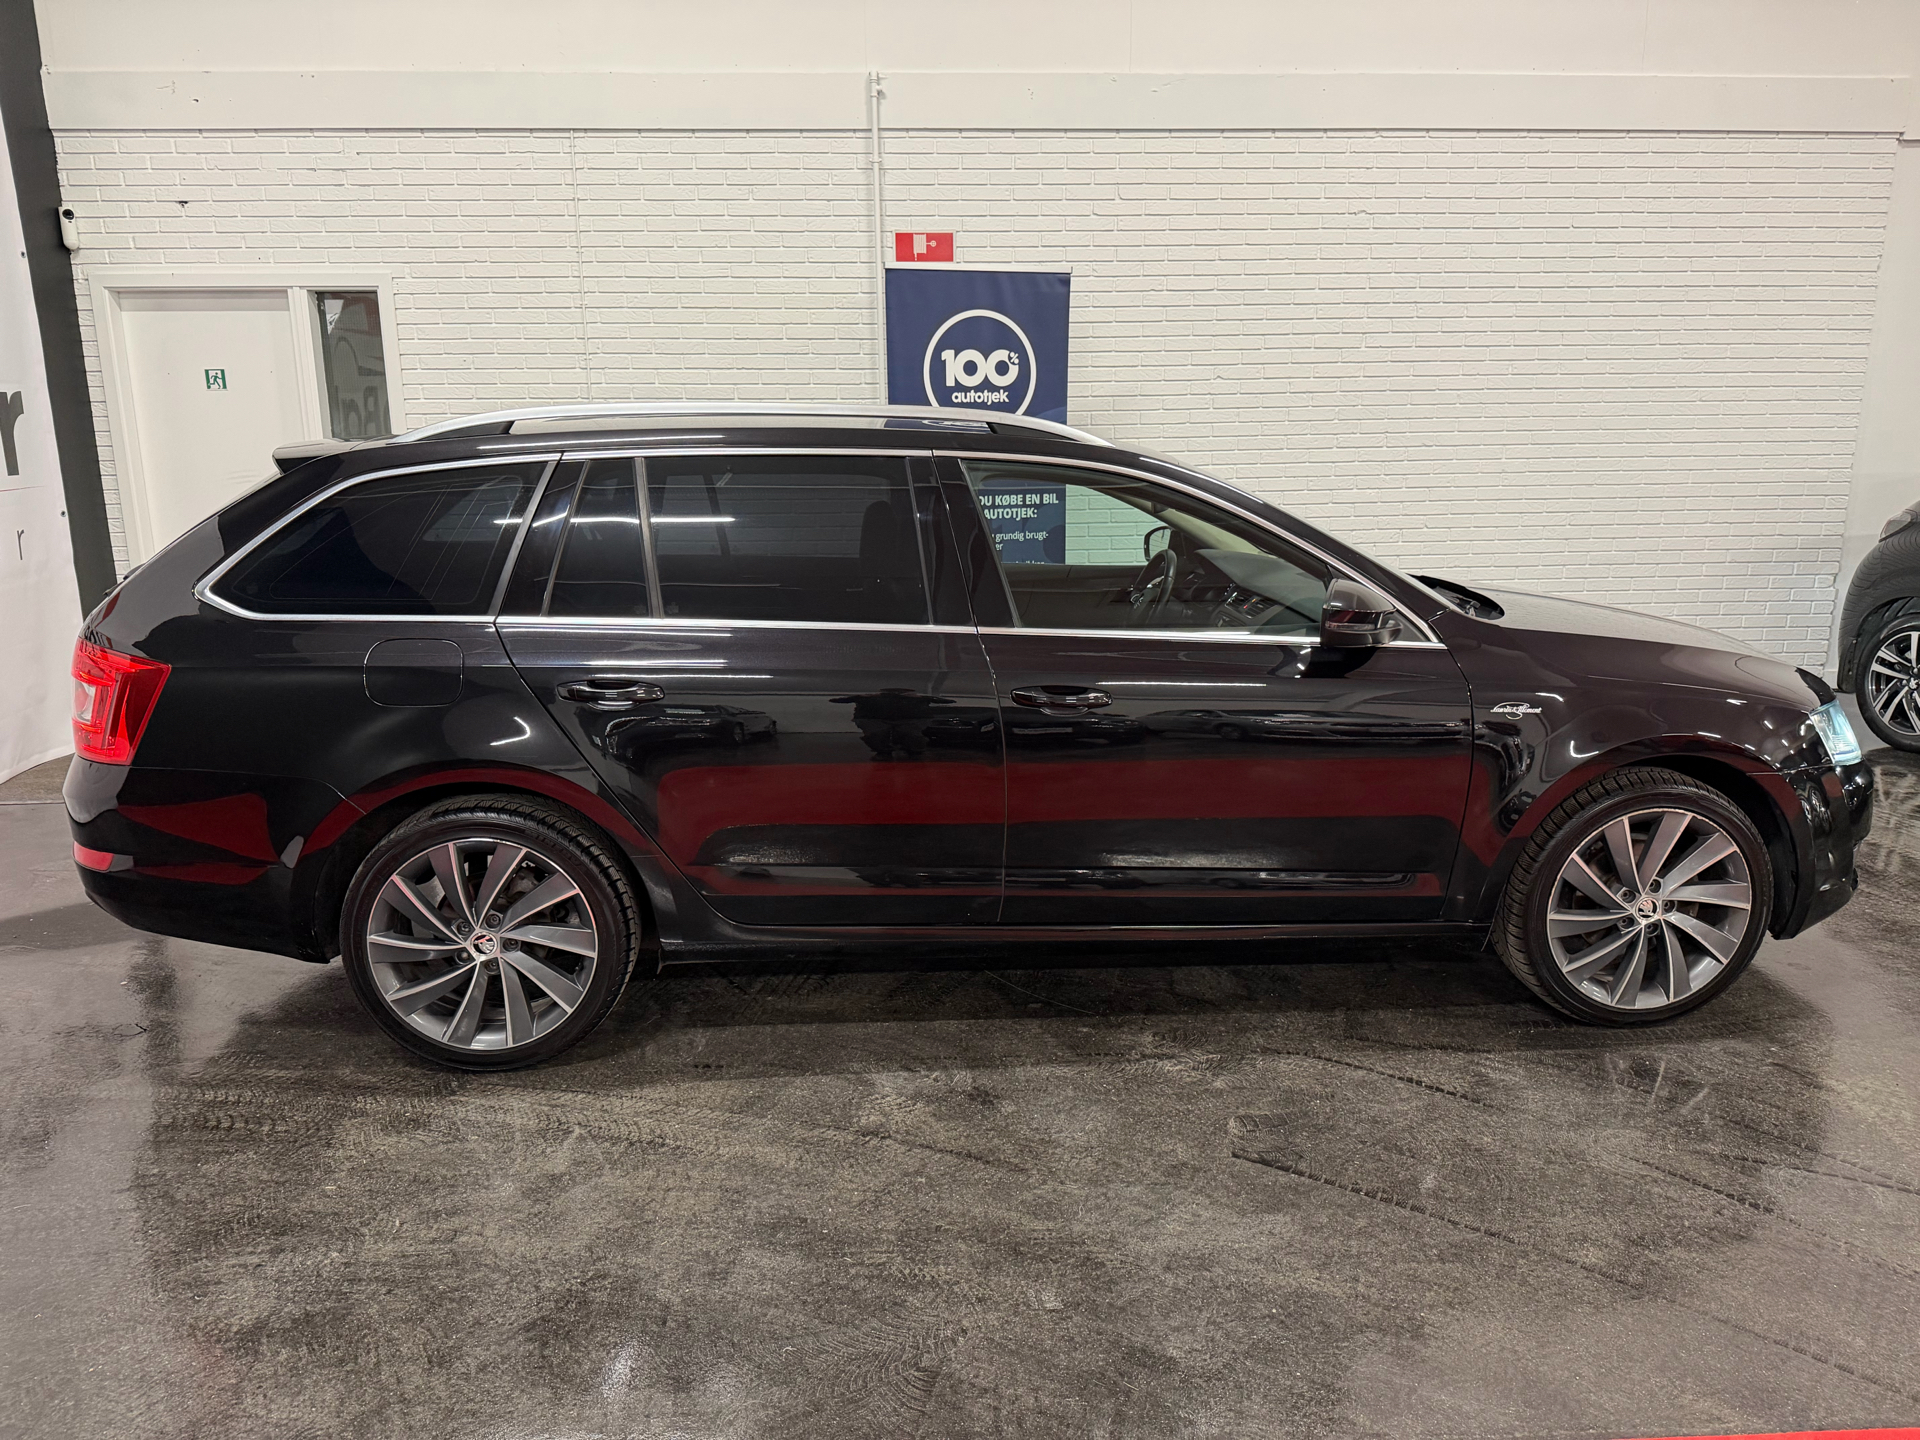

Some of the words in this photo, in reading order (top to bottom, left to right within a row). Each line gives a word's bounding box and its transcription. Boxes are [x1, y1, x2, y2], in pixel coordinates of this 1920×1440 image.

[941, 349, 1019, 387] 100%
[951, 389, 1009, 405] autotjek
[995, 494, 1023, 506] KØBE
[1025, 494, 1040, 505] EN
[1043, 493, 1059, 504] BIL
[995, 531, 1024, 542] grundig
[1026, 530, 1049, 542] brugt-
